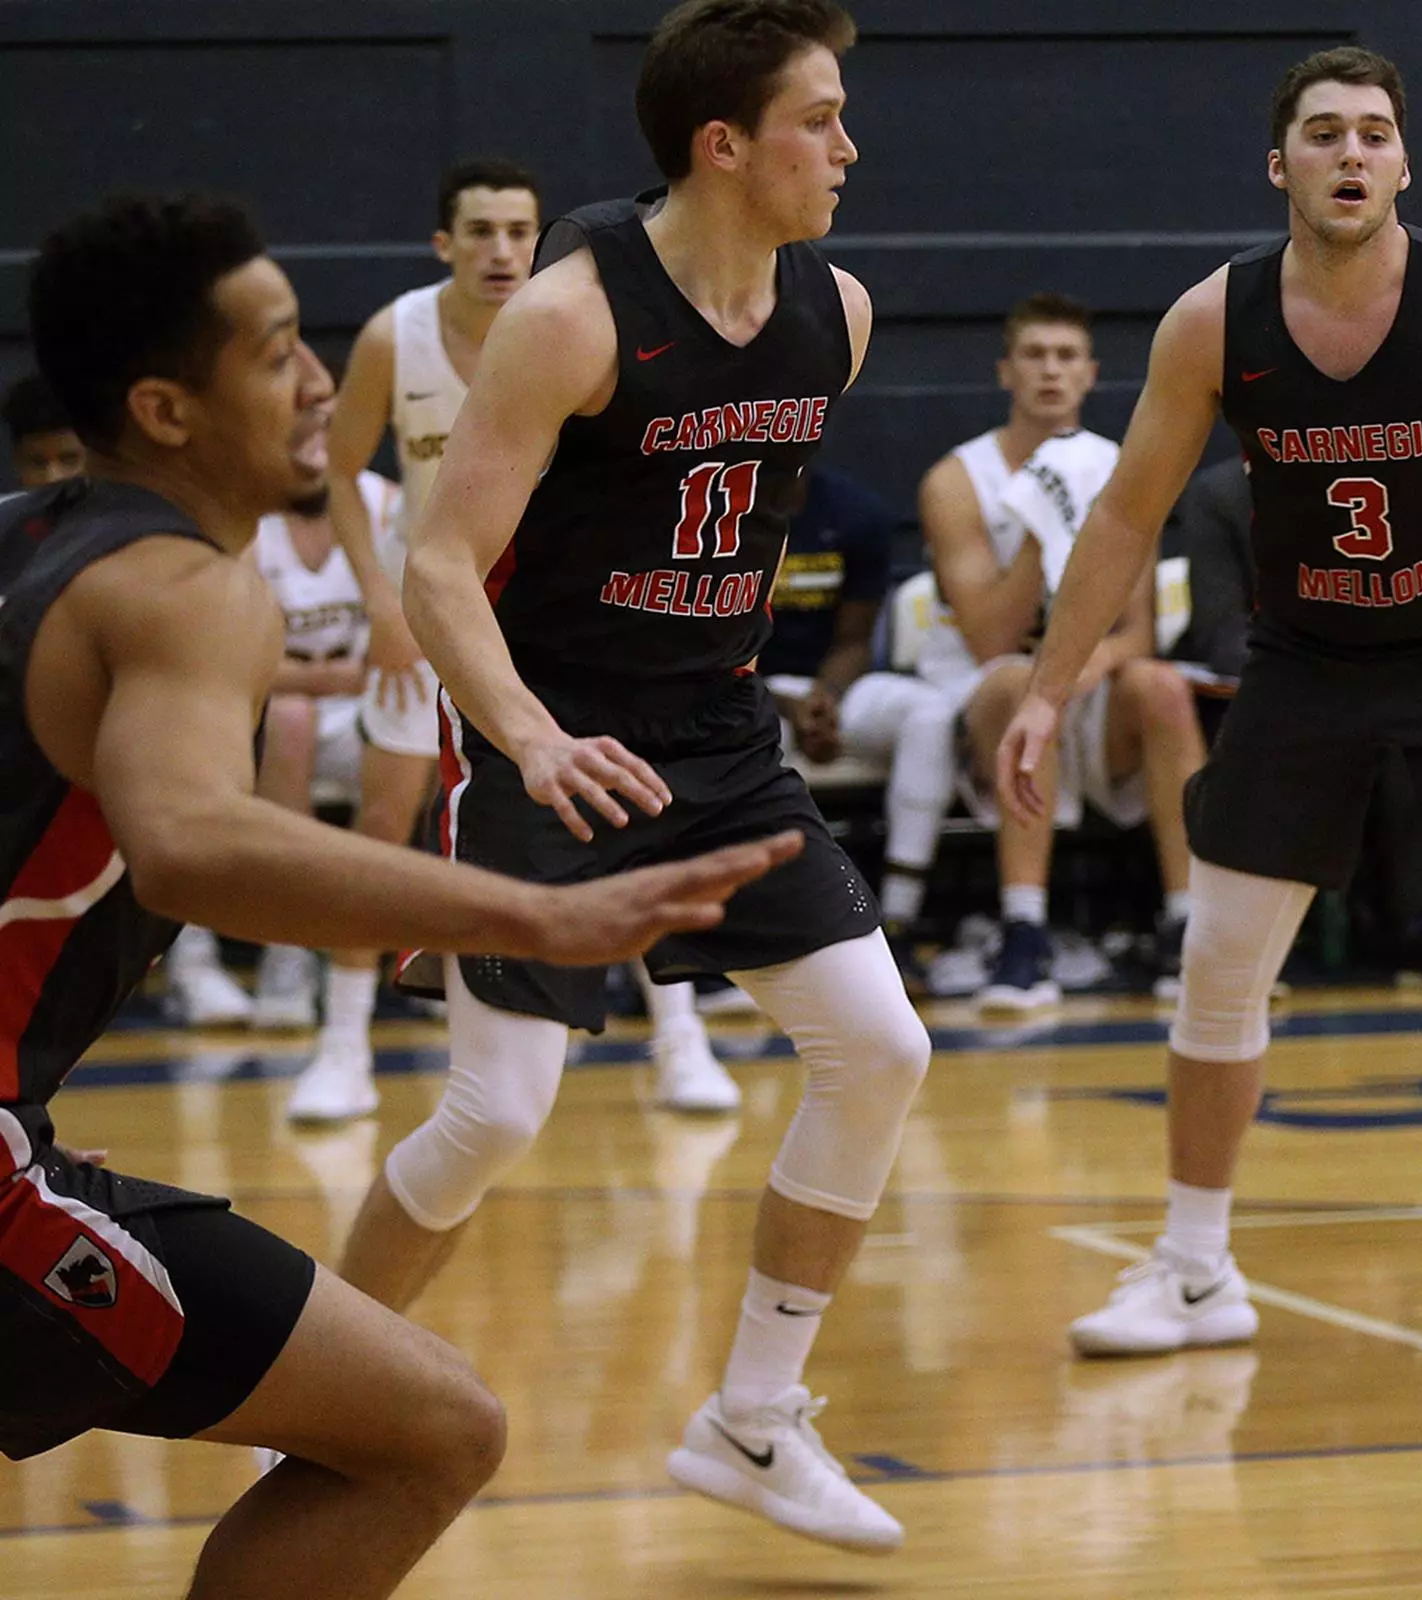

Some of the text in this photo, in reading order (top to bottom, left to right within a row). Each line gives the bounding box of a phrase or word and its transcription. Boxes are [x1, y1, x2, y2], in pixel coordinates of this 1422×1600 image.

[640, 397, 829, 456] CARNEGIE
[671, 460, 762, 560] 11
[1326, 477, 1394, 562] 3
[599, 569, 764, 618] MELLON
